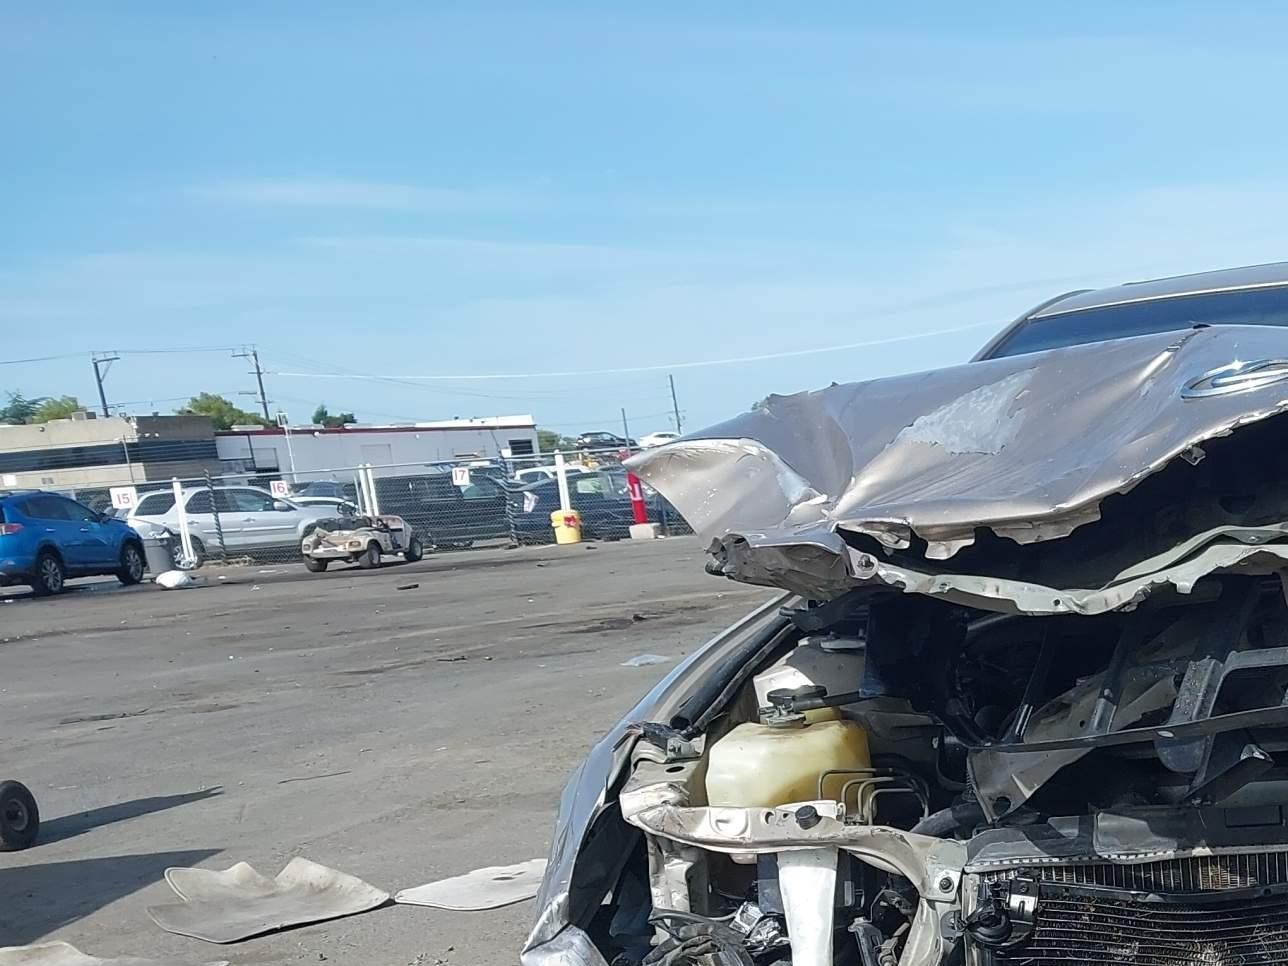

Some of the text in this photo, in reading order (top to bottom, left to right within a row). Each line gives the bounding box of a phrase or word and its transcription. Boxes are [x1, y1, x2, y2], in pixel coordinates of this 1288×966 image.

[454, 469, 466, 481] 17
[271, 482, 285, 494] 16
[116, 493, 130, 504] 15
